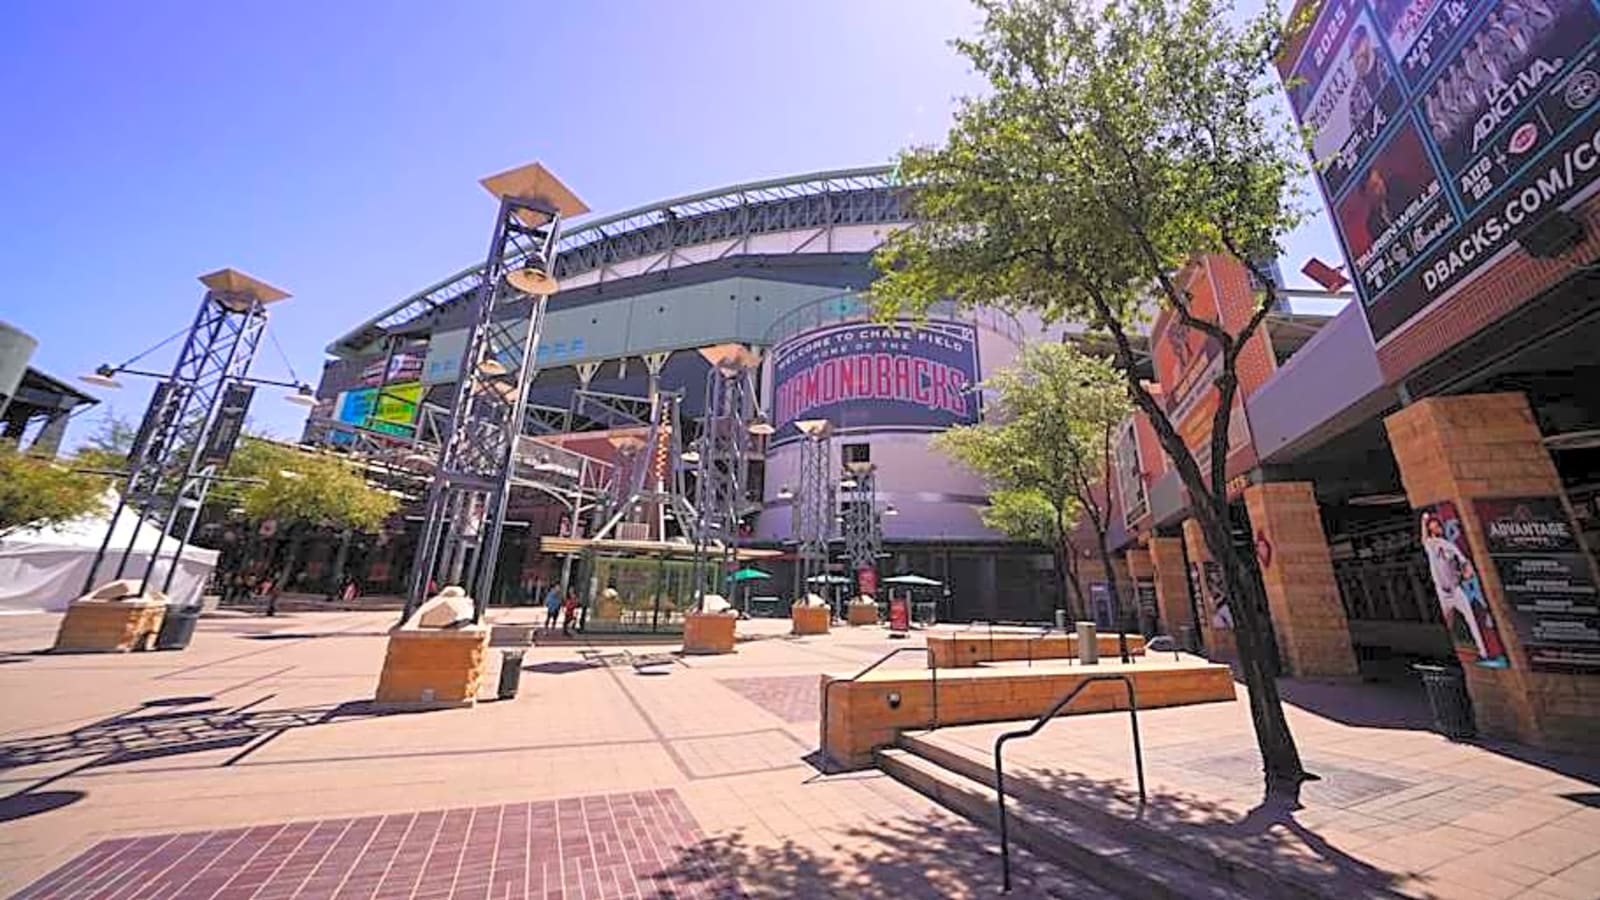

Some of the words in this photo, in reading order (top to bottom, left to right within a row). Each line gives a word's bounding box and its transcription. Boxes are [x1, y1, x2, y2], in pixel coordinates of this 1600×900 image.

[1313, 3, 1347, 67] 2025
[1405, 26, 1434, 69] MAY
[1485, 80, 1508, 105] LA
[1460, 156, 1492, 194] AUG
[1471, 175, 1493, 200] 22
[778, 337, 831, 368] WELCOME
[835, 332, 854, 342] TO
[860, 330, 911, 339] CHASE
[919, 333, 963, 352] FIELD
[812, 345, 848, 360] HOME
[854, 342, 873, 351] OF
[882, 342, 909, 350] THE
[776, 353, 967, 427] DIAMONDBACKS
[1488, 521, 1571, 537] ADVANTAGE
